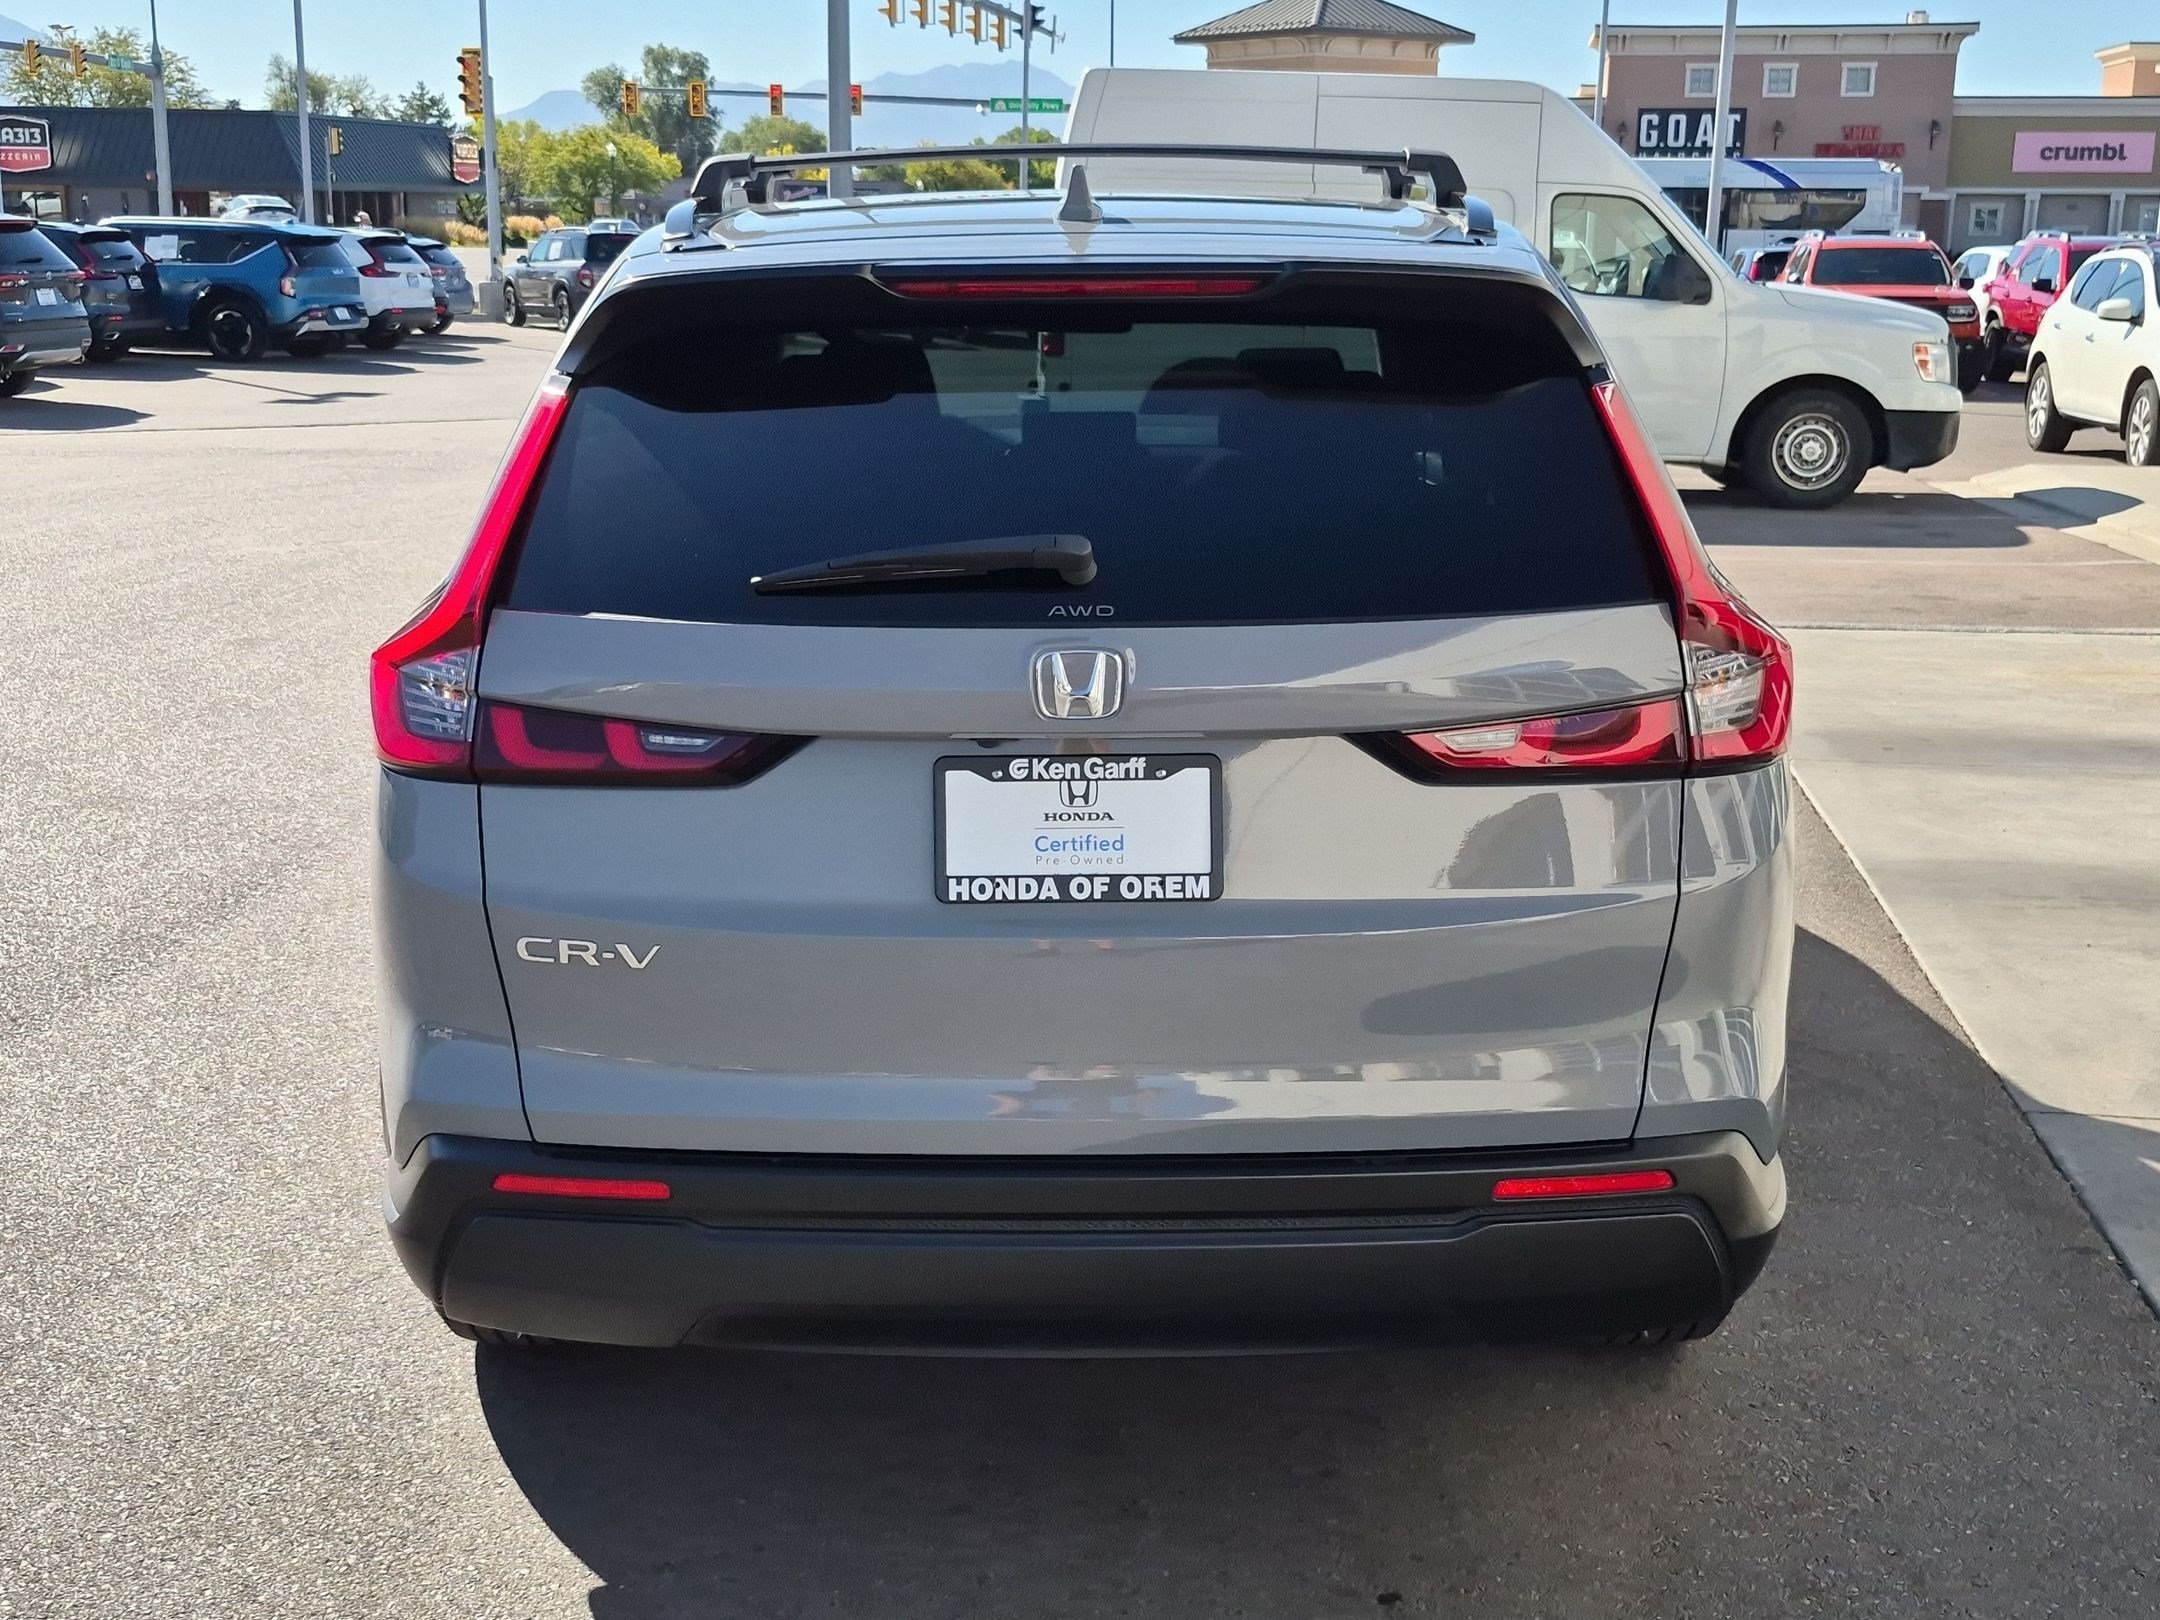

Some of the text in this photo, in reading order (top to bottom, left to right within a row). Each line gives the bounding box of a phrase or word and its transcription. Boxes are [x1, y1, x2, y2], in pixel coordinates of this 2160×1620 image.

[0, 127, 42, 143] A313
[1639, 113, 1741, 148] G.O.AT.
[2040, 142, 2128, 161] crumbl
[1047, 605, 1114, 616] AWD
[1032, 757, 1146, 780] Ken Garff
[1043, 812, 1115, 822] HONDA
[1035, 834, 1124, 852] Certified
[1035, 855, 1124, 865] Pre-Owned
[948, 876, 1210, 901] HONDA OF OREM
[516, 936, 661, 969] CR-V
